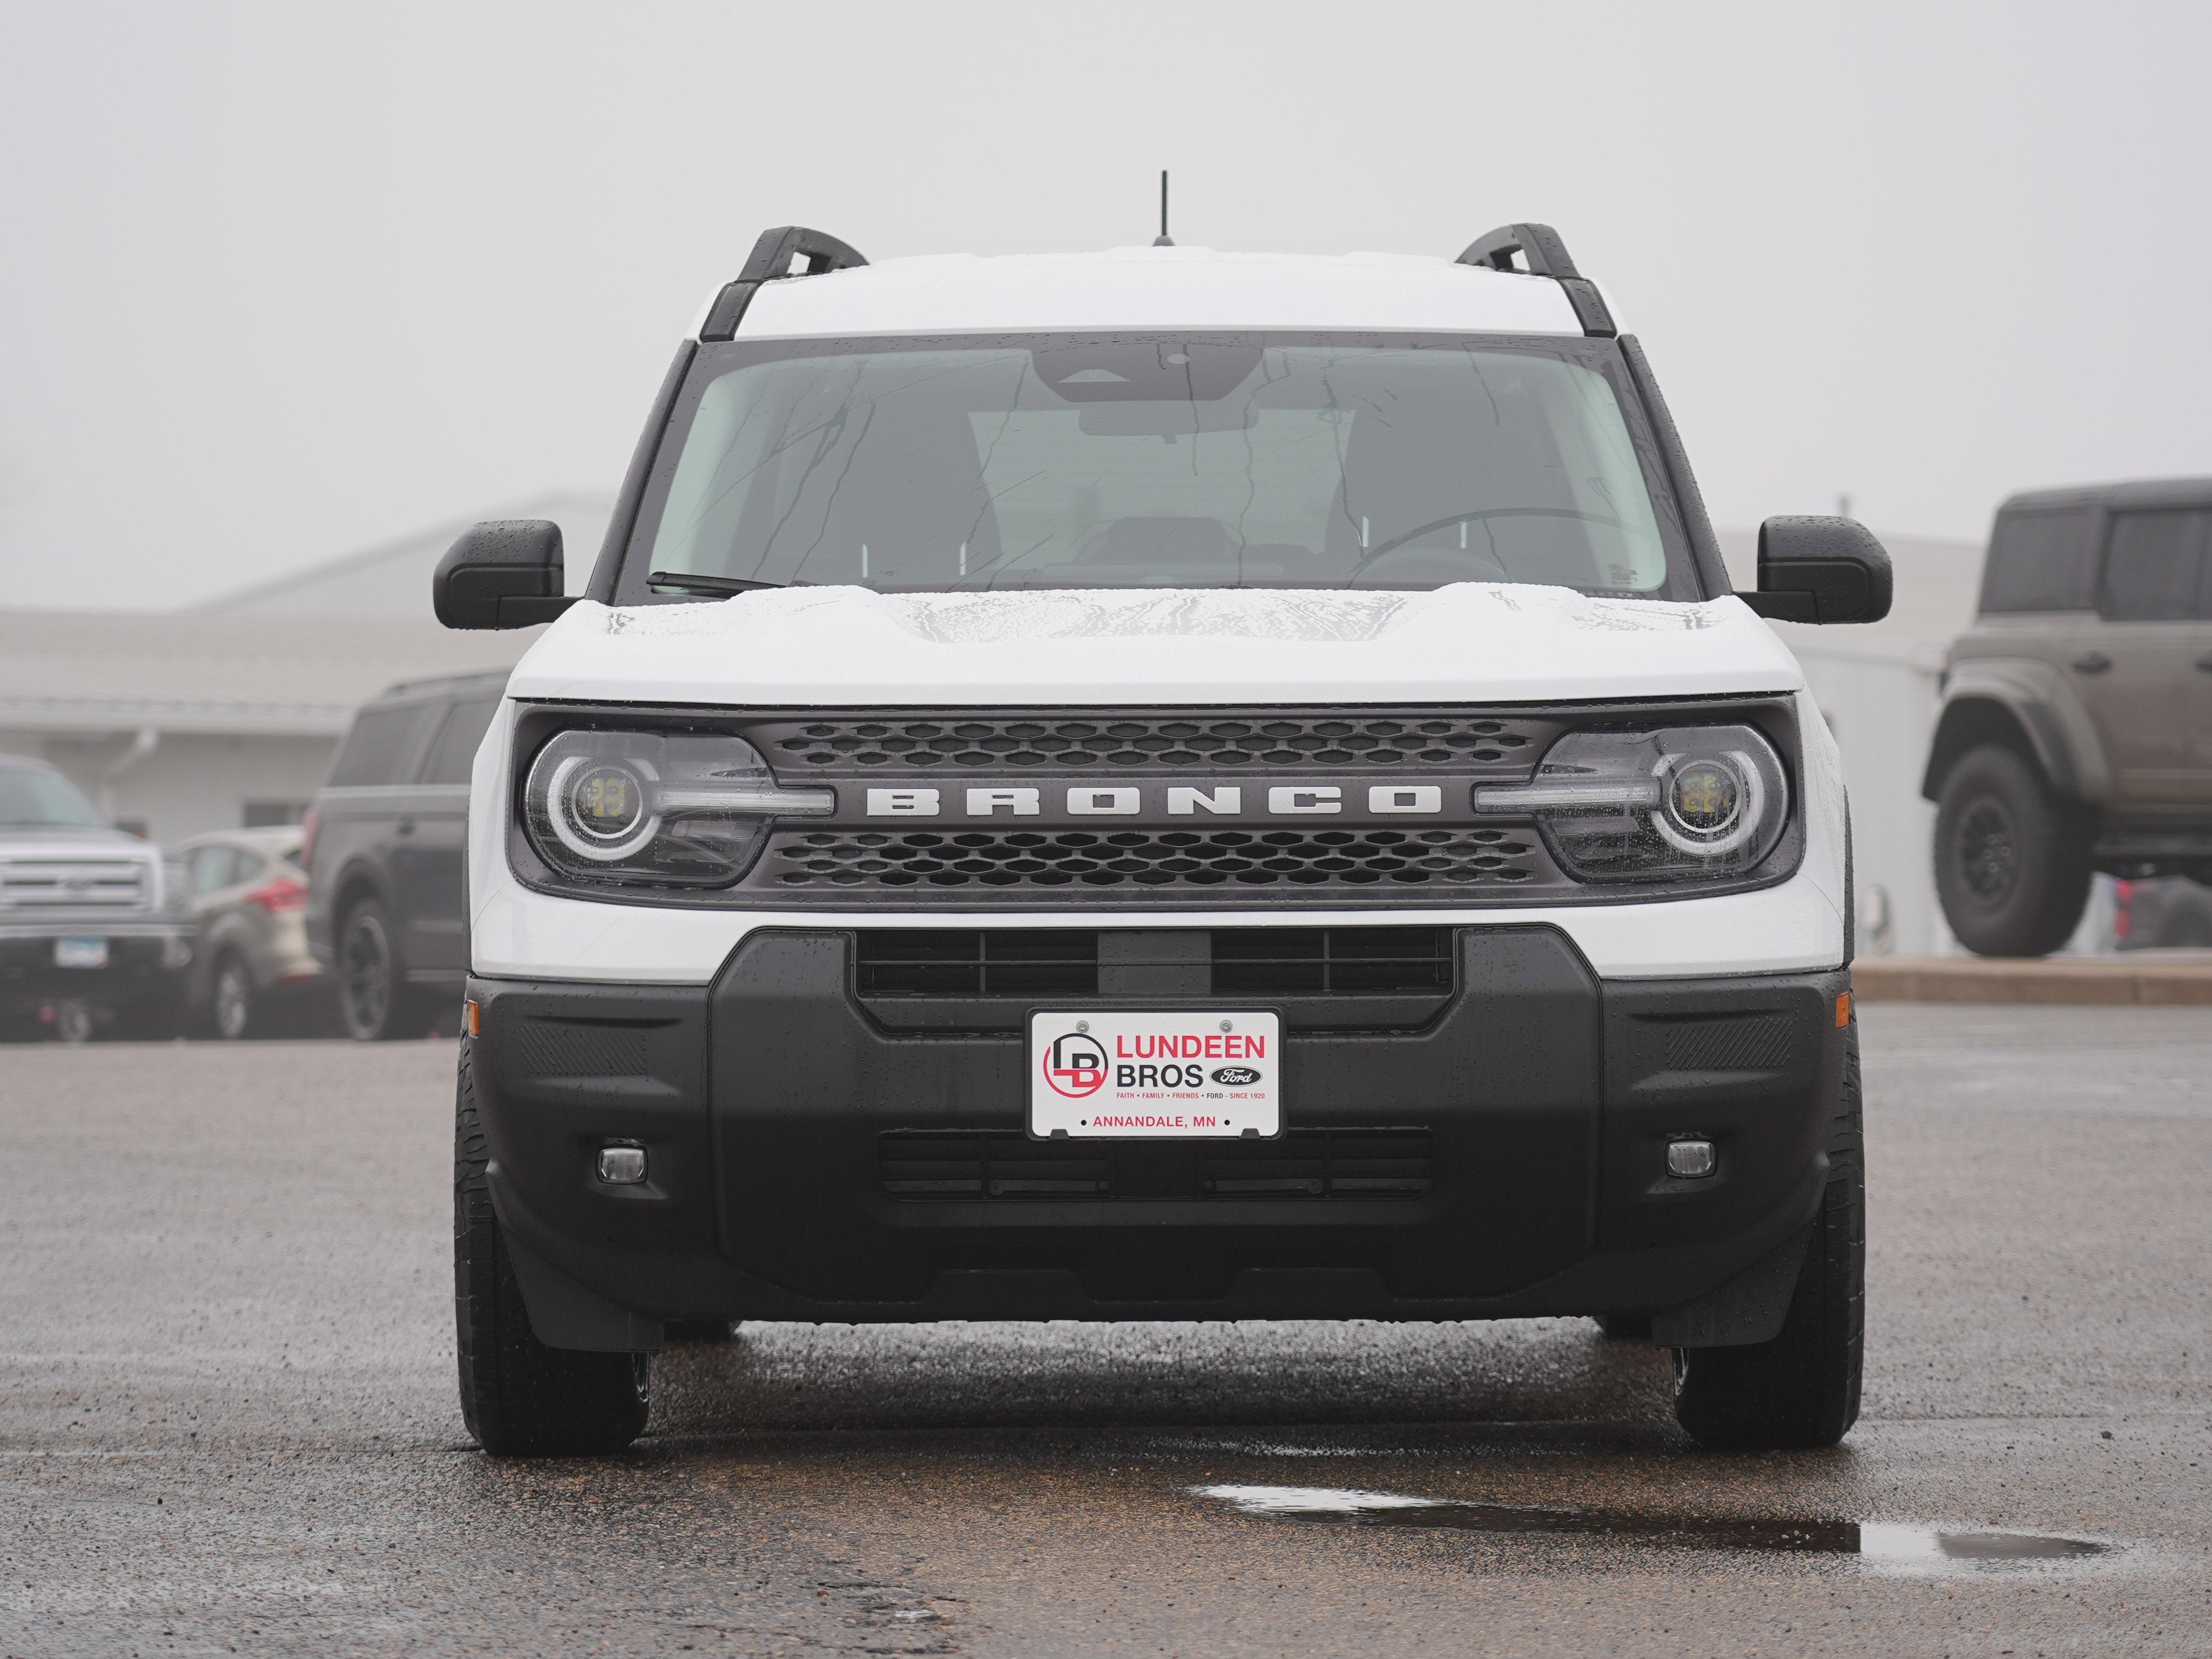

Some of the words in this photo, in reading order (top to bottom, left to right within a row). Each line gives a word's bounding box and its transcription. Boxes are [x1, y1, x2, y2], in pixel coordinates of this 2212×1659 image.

[866, 786, 1442, 817] BRONCO
[1117, 1035, 1265, 1058] LUNDEEN
[1117, 1064, 1204, 1088] BROS
[1093, 1116, 1188, 1128] ANNANDALE,
[1193, 1116, 1216, 1127] MN
